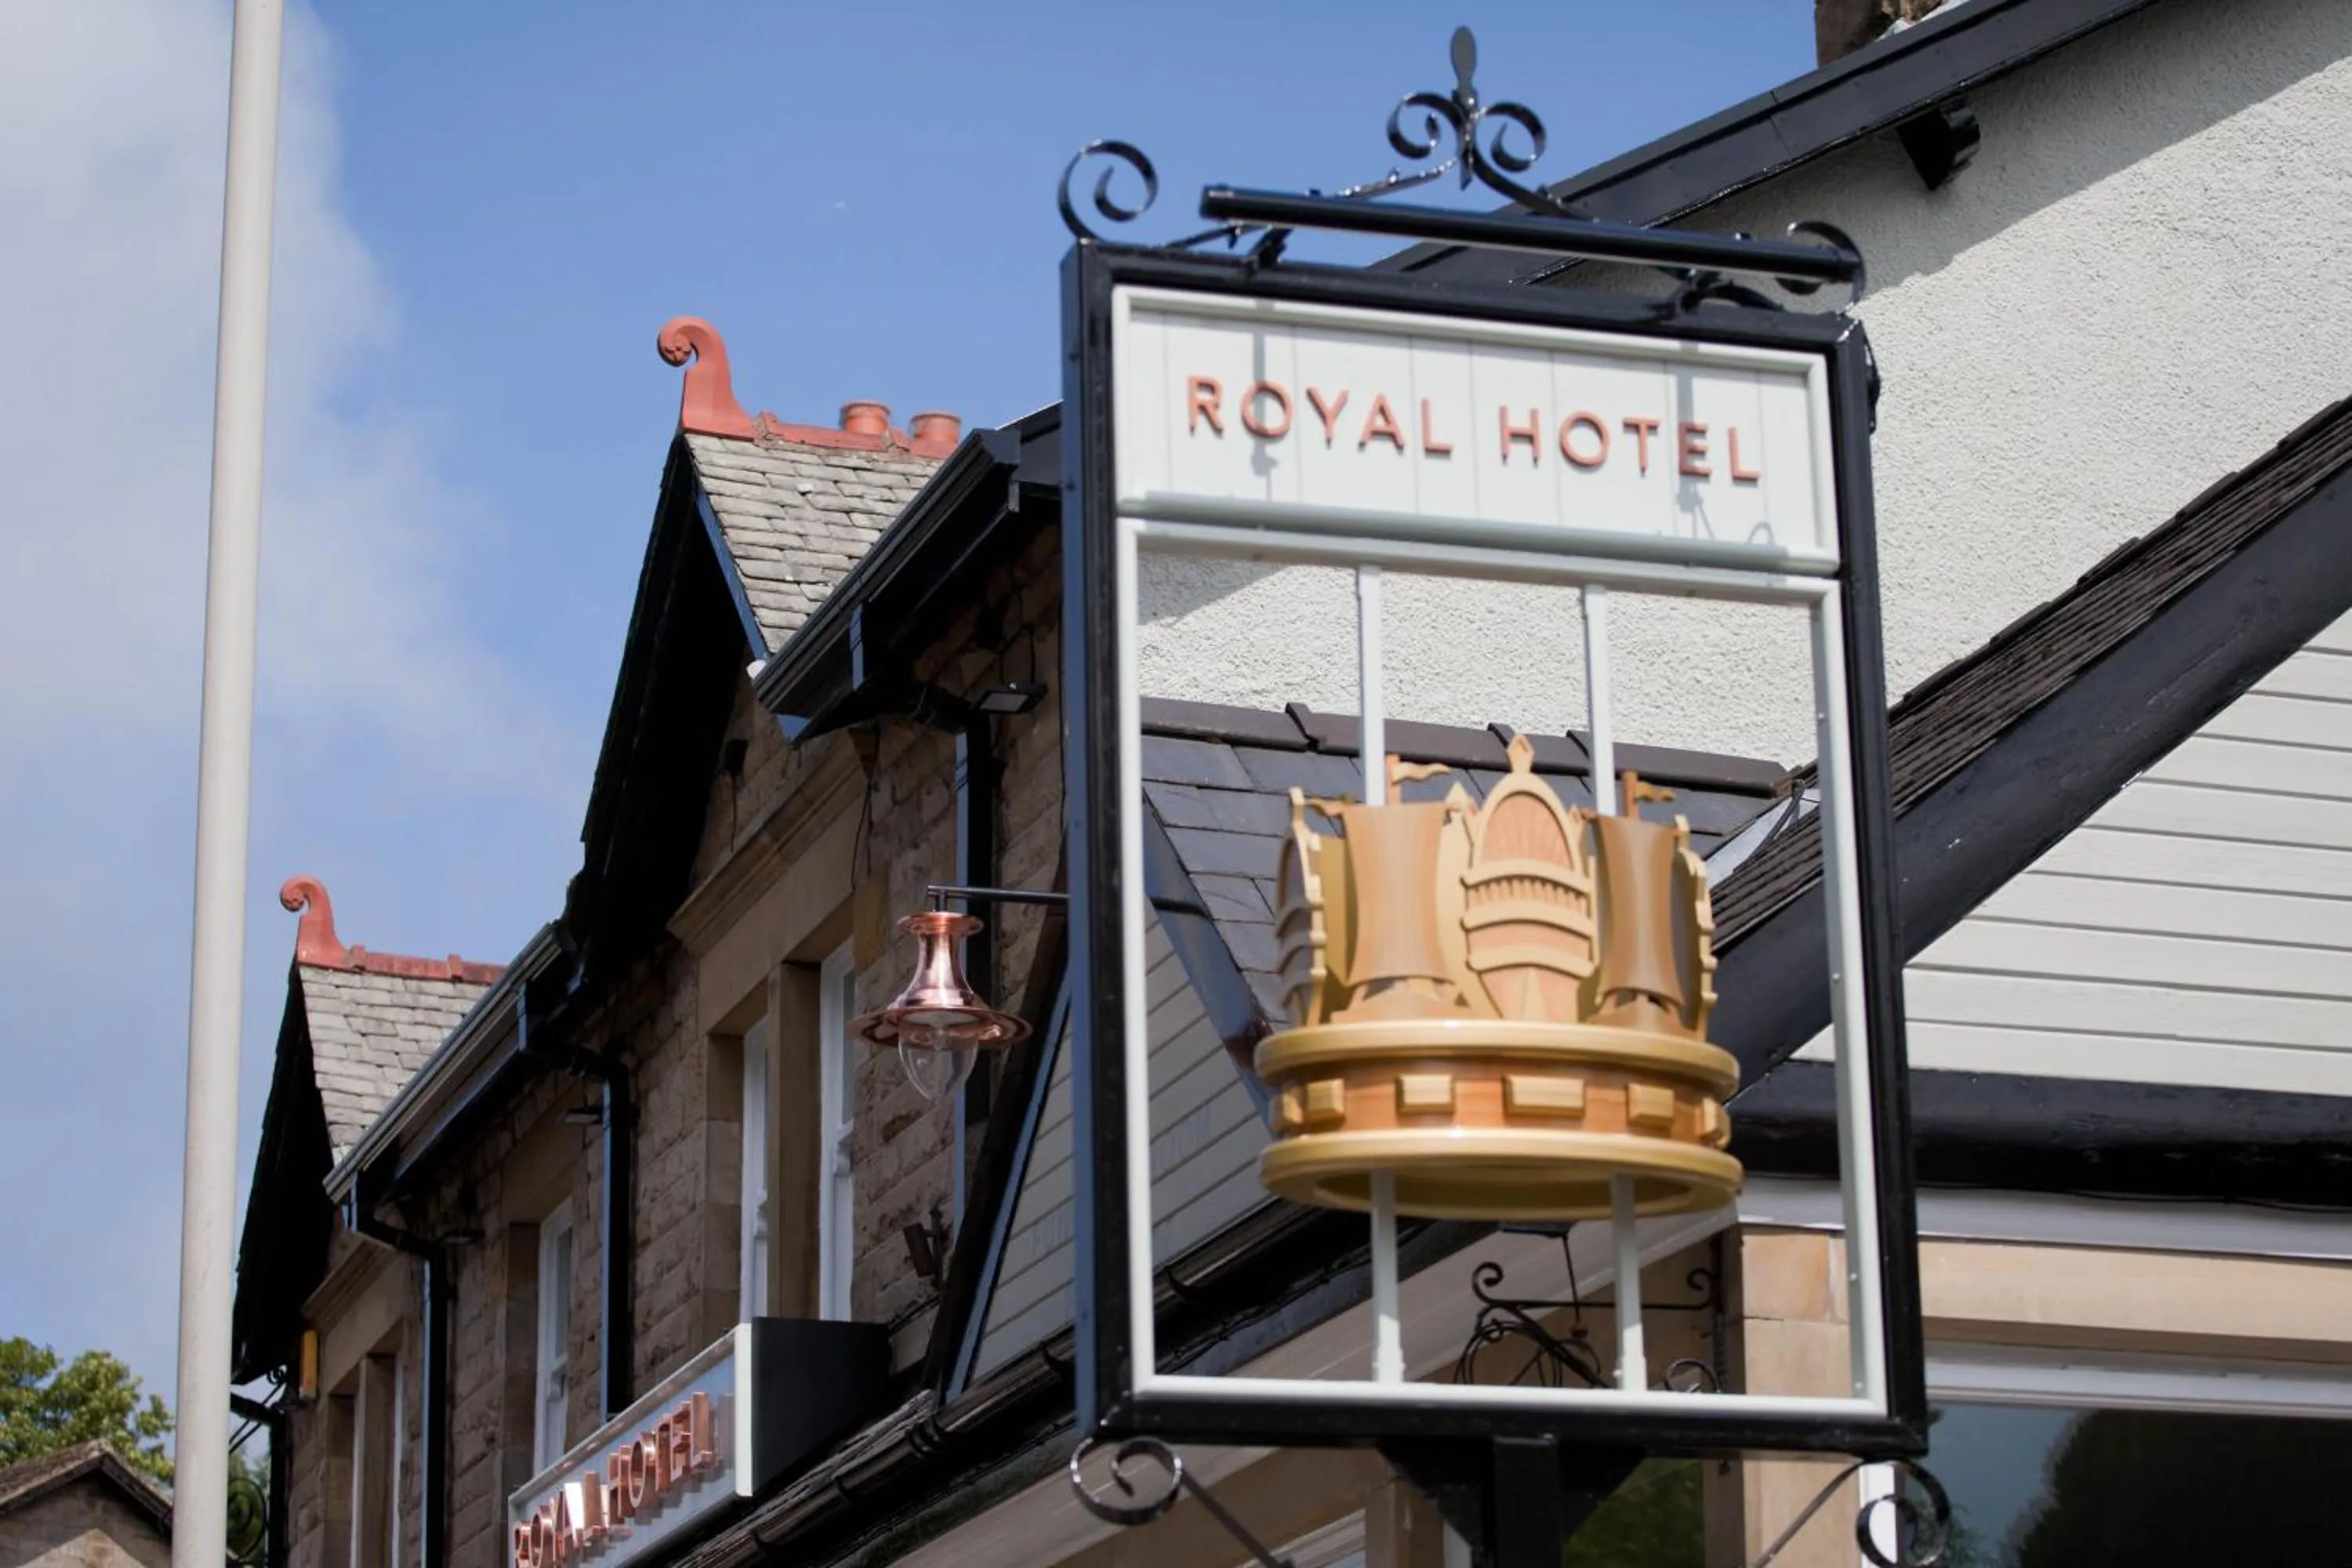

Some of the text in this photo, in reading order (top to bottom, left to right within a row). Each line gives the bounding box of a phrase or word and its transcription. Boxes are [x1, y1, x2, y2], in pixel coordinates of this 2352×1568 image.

[1187, 375, 1761, 483] ROYAL HOTEL
[607, 1392, 715, 1525] HOTEL
